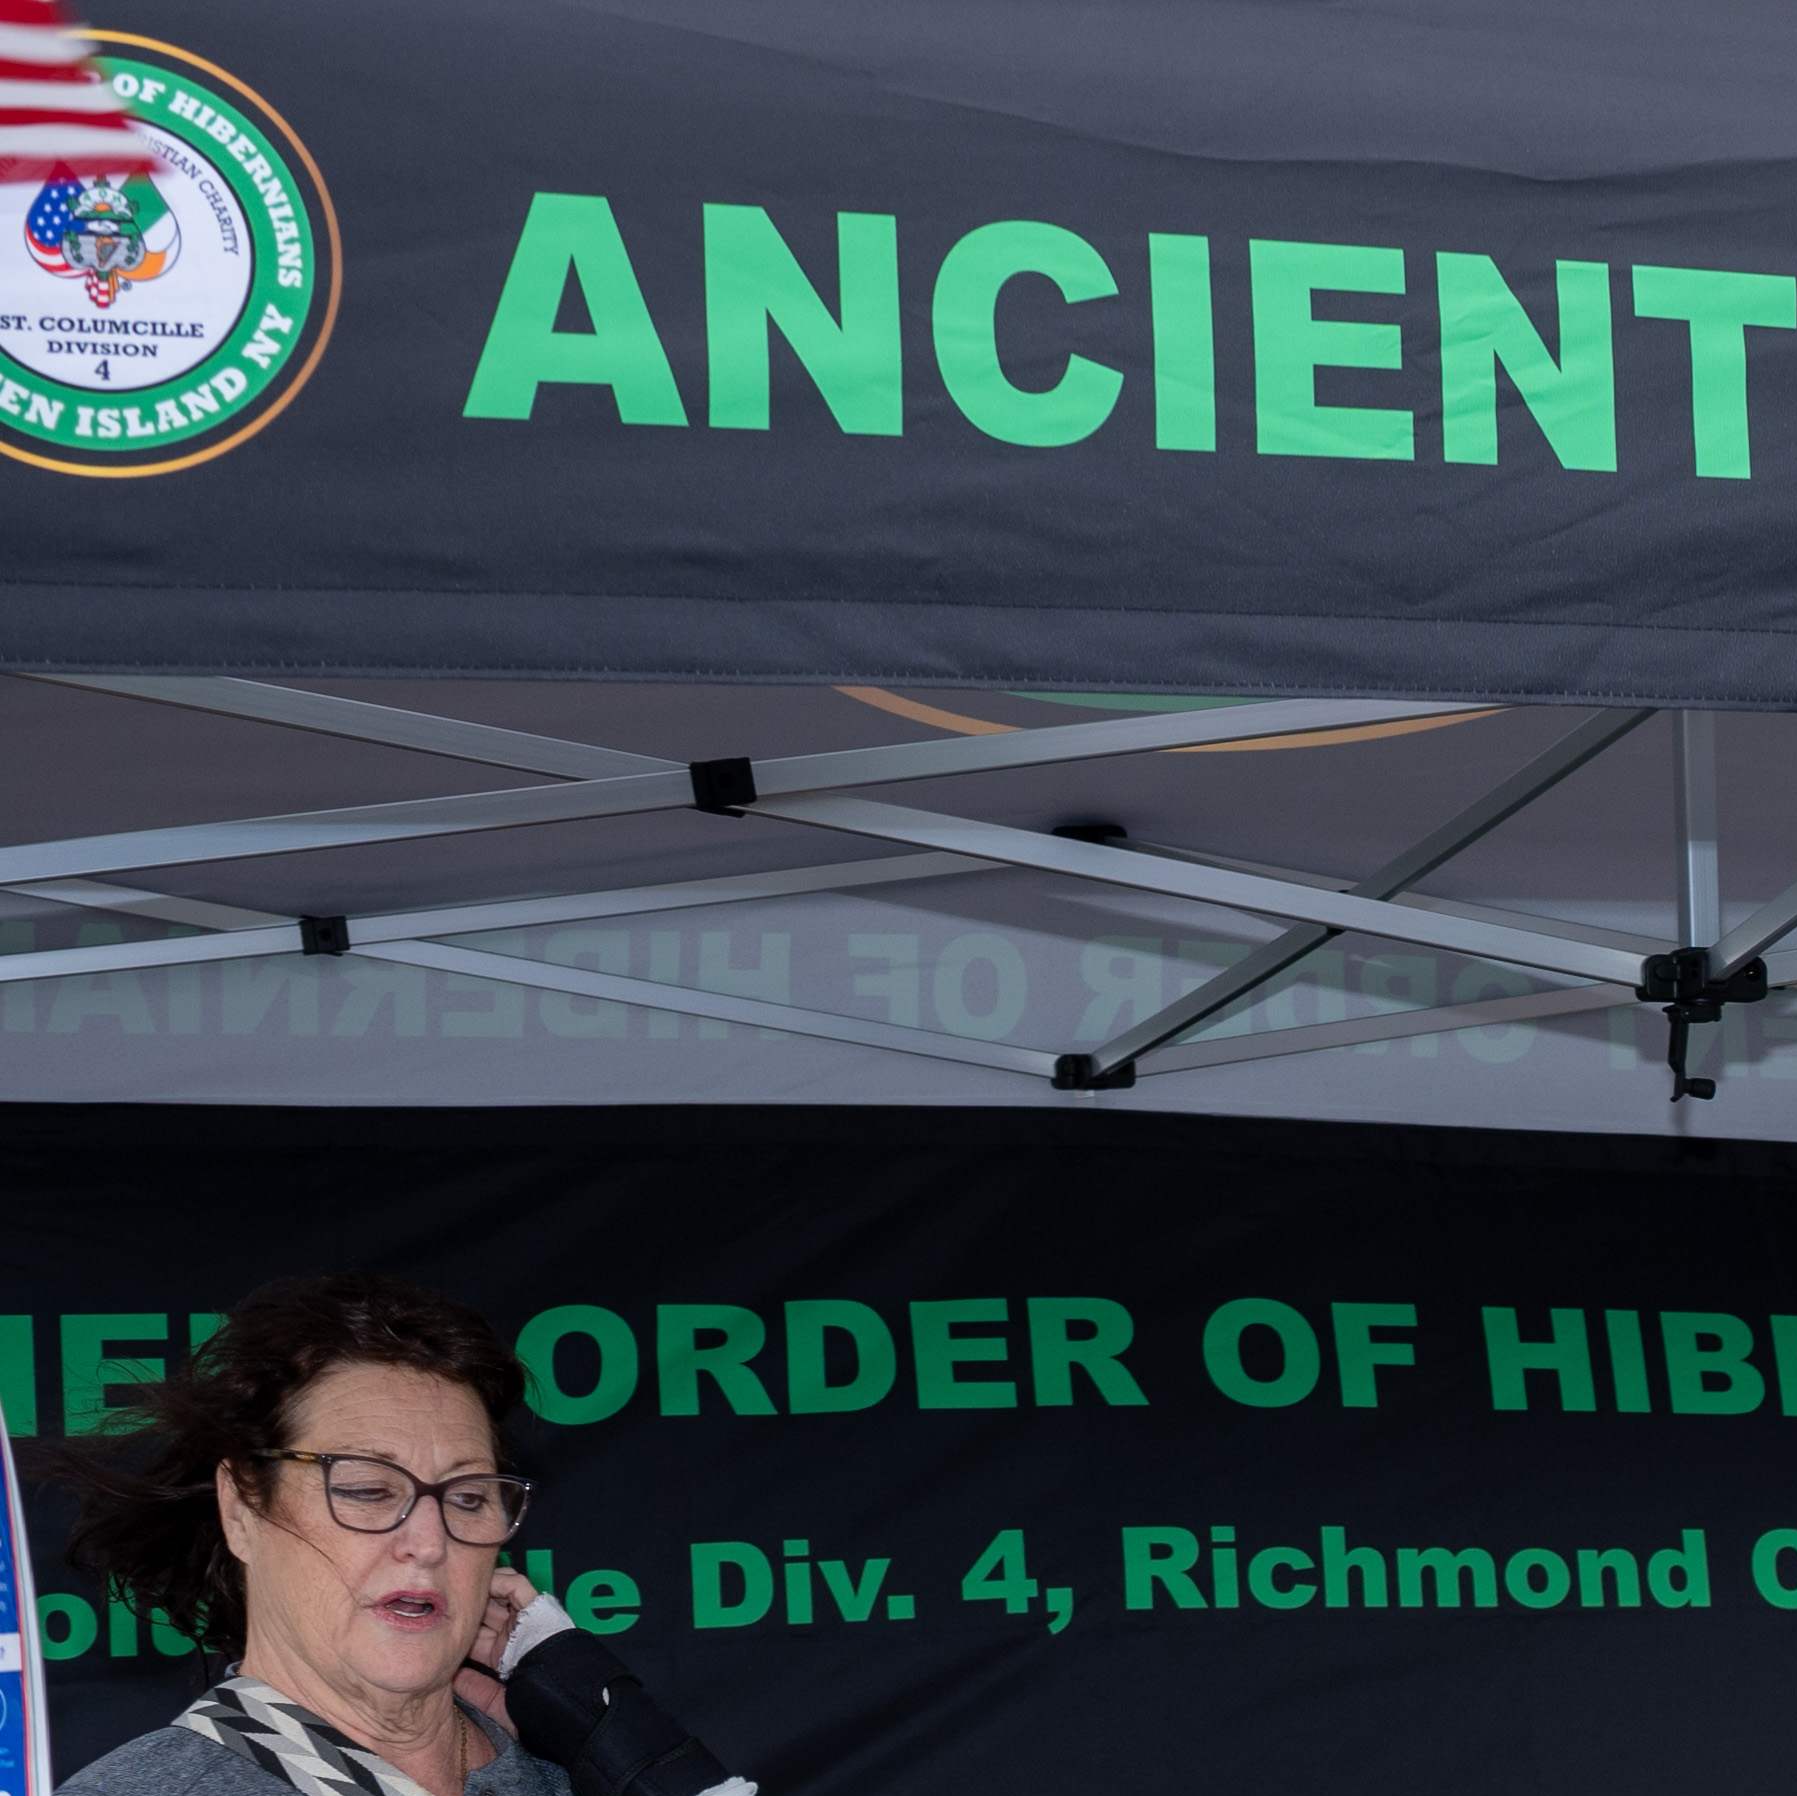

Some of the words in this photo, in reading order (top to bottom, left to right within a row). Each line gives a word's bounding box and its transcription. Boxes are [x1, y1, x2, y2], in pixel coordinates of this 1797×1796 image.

[112, 72, 165, 105] OF
[168, 89, 303, 288] HIBERNIANS
[198, 177, 239, 257] CHARITY
[39, 317, 204, 338] COLUMCILLE
[46, 341, 158, 357] DIVISION
[75, 367, 248, 438] ISLAND
[242, 303, 293, 368] NY
[94, 360, 111, 381] 4
[462, 190, 1797, 480] ANCIENT
[515, 1298, 1149, 1425] ORDER
[1203, 1298, 1417, 1407] OF
[690, 1538, 915, 1629] Div.
[962, 1530, 1073, 1635] 4,
[1122, 1526, 1711, 1610] Richmond
